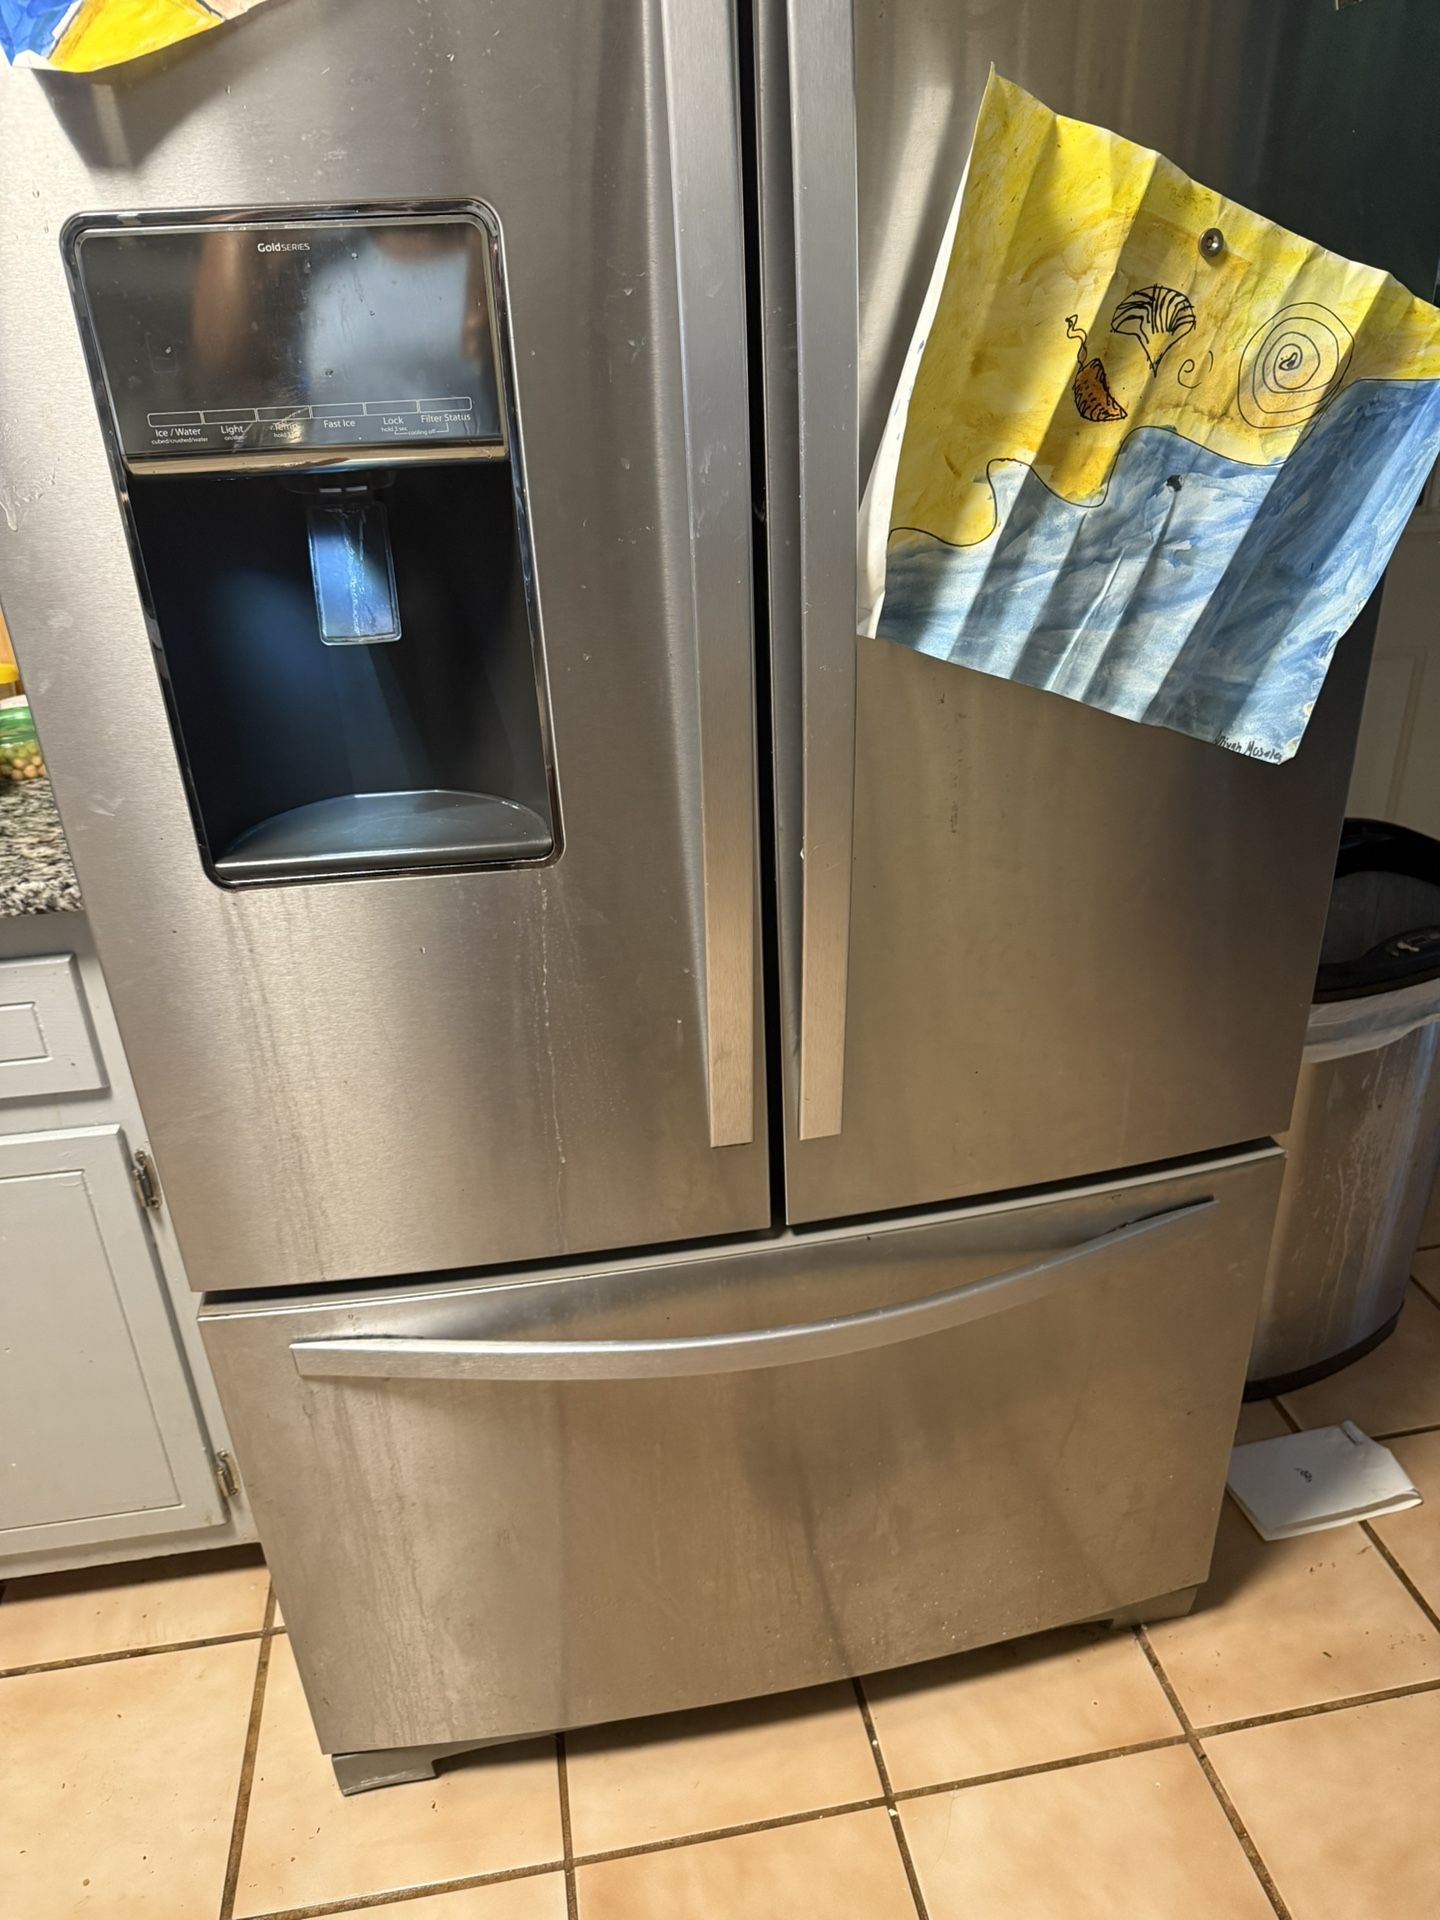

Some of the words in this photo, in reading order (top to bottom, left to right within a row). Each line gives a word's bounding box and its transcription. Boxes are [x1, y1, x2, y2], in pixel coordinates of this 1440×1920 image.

[383, 416, 404, 425] Lock
[421, 414, 442, 423] Filter
[444, 412, 472, 422] Status
[323, 419, 342, 429] Fast
[343, 418, 357, 428] Ice
[155, 428, 169, 437] Ice
[175, 427, 201, 436] Water
[220, 424, 244, 436] Light
